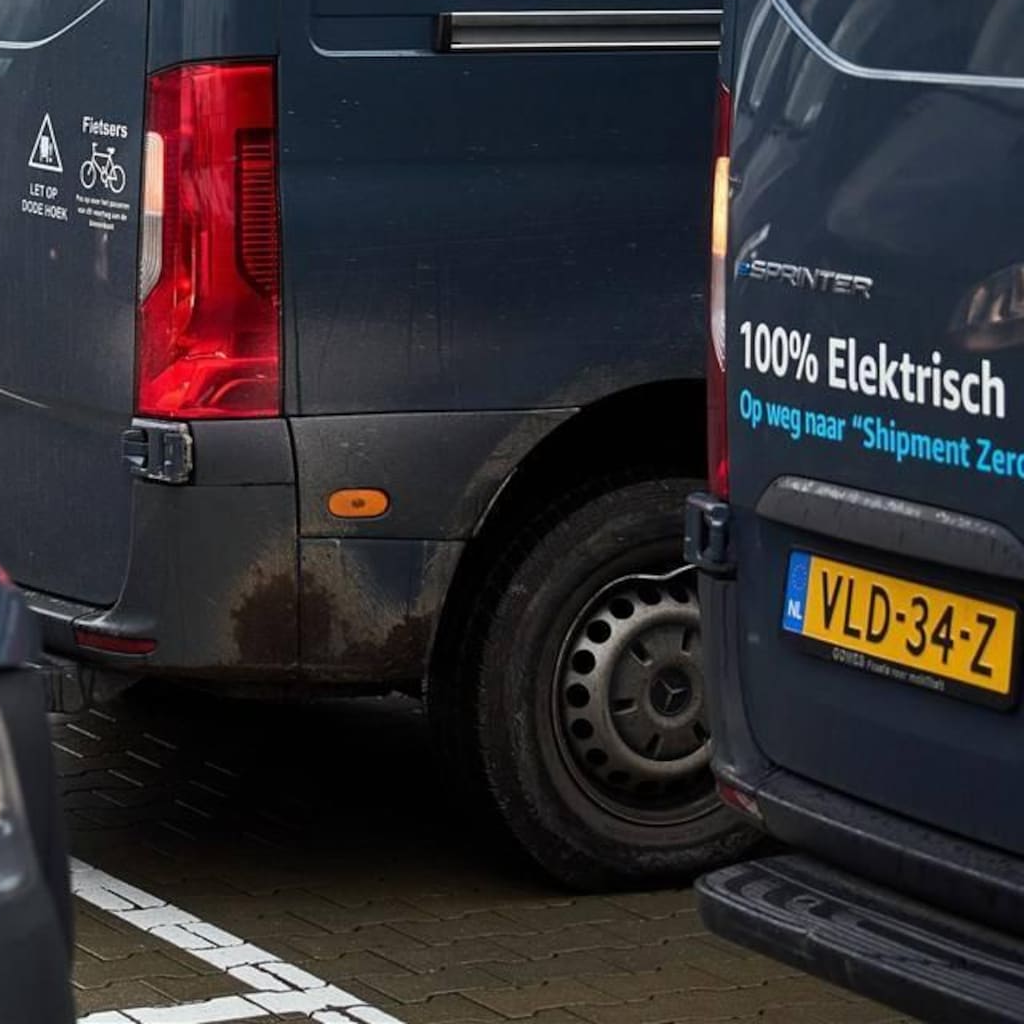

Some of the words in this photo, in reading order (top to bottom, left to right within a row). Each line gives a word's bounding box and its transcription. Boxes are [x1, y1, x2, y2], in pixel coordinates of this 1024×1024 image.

[82, 116, 128, 138] Fietsers
[29, 183, 45, 197] LET
[21, 199, 44, 216] DODE
[740, 321, 818, 383] 100%
[829, 337, 1006, 419] Elektrisch
[740, 389, 763, 429] Op
[766, 402, 801, 440] weg
[805, 411, 846, 441] naar
[787, 599, 803, 620] NL
[822, 571, 997, 678] VLD-34-Z
